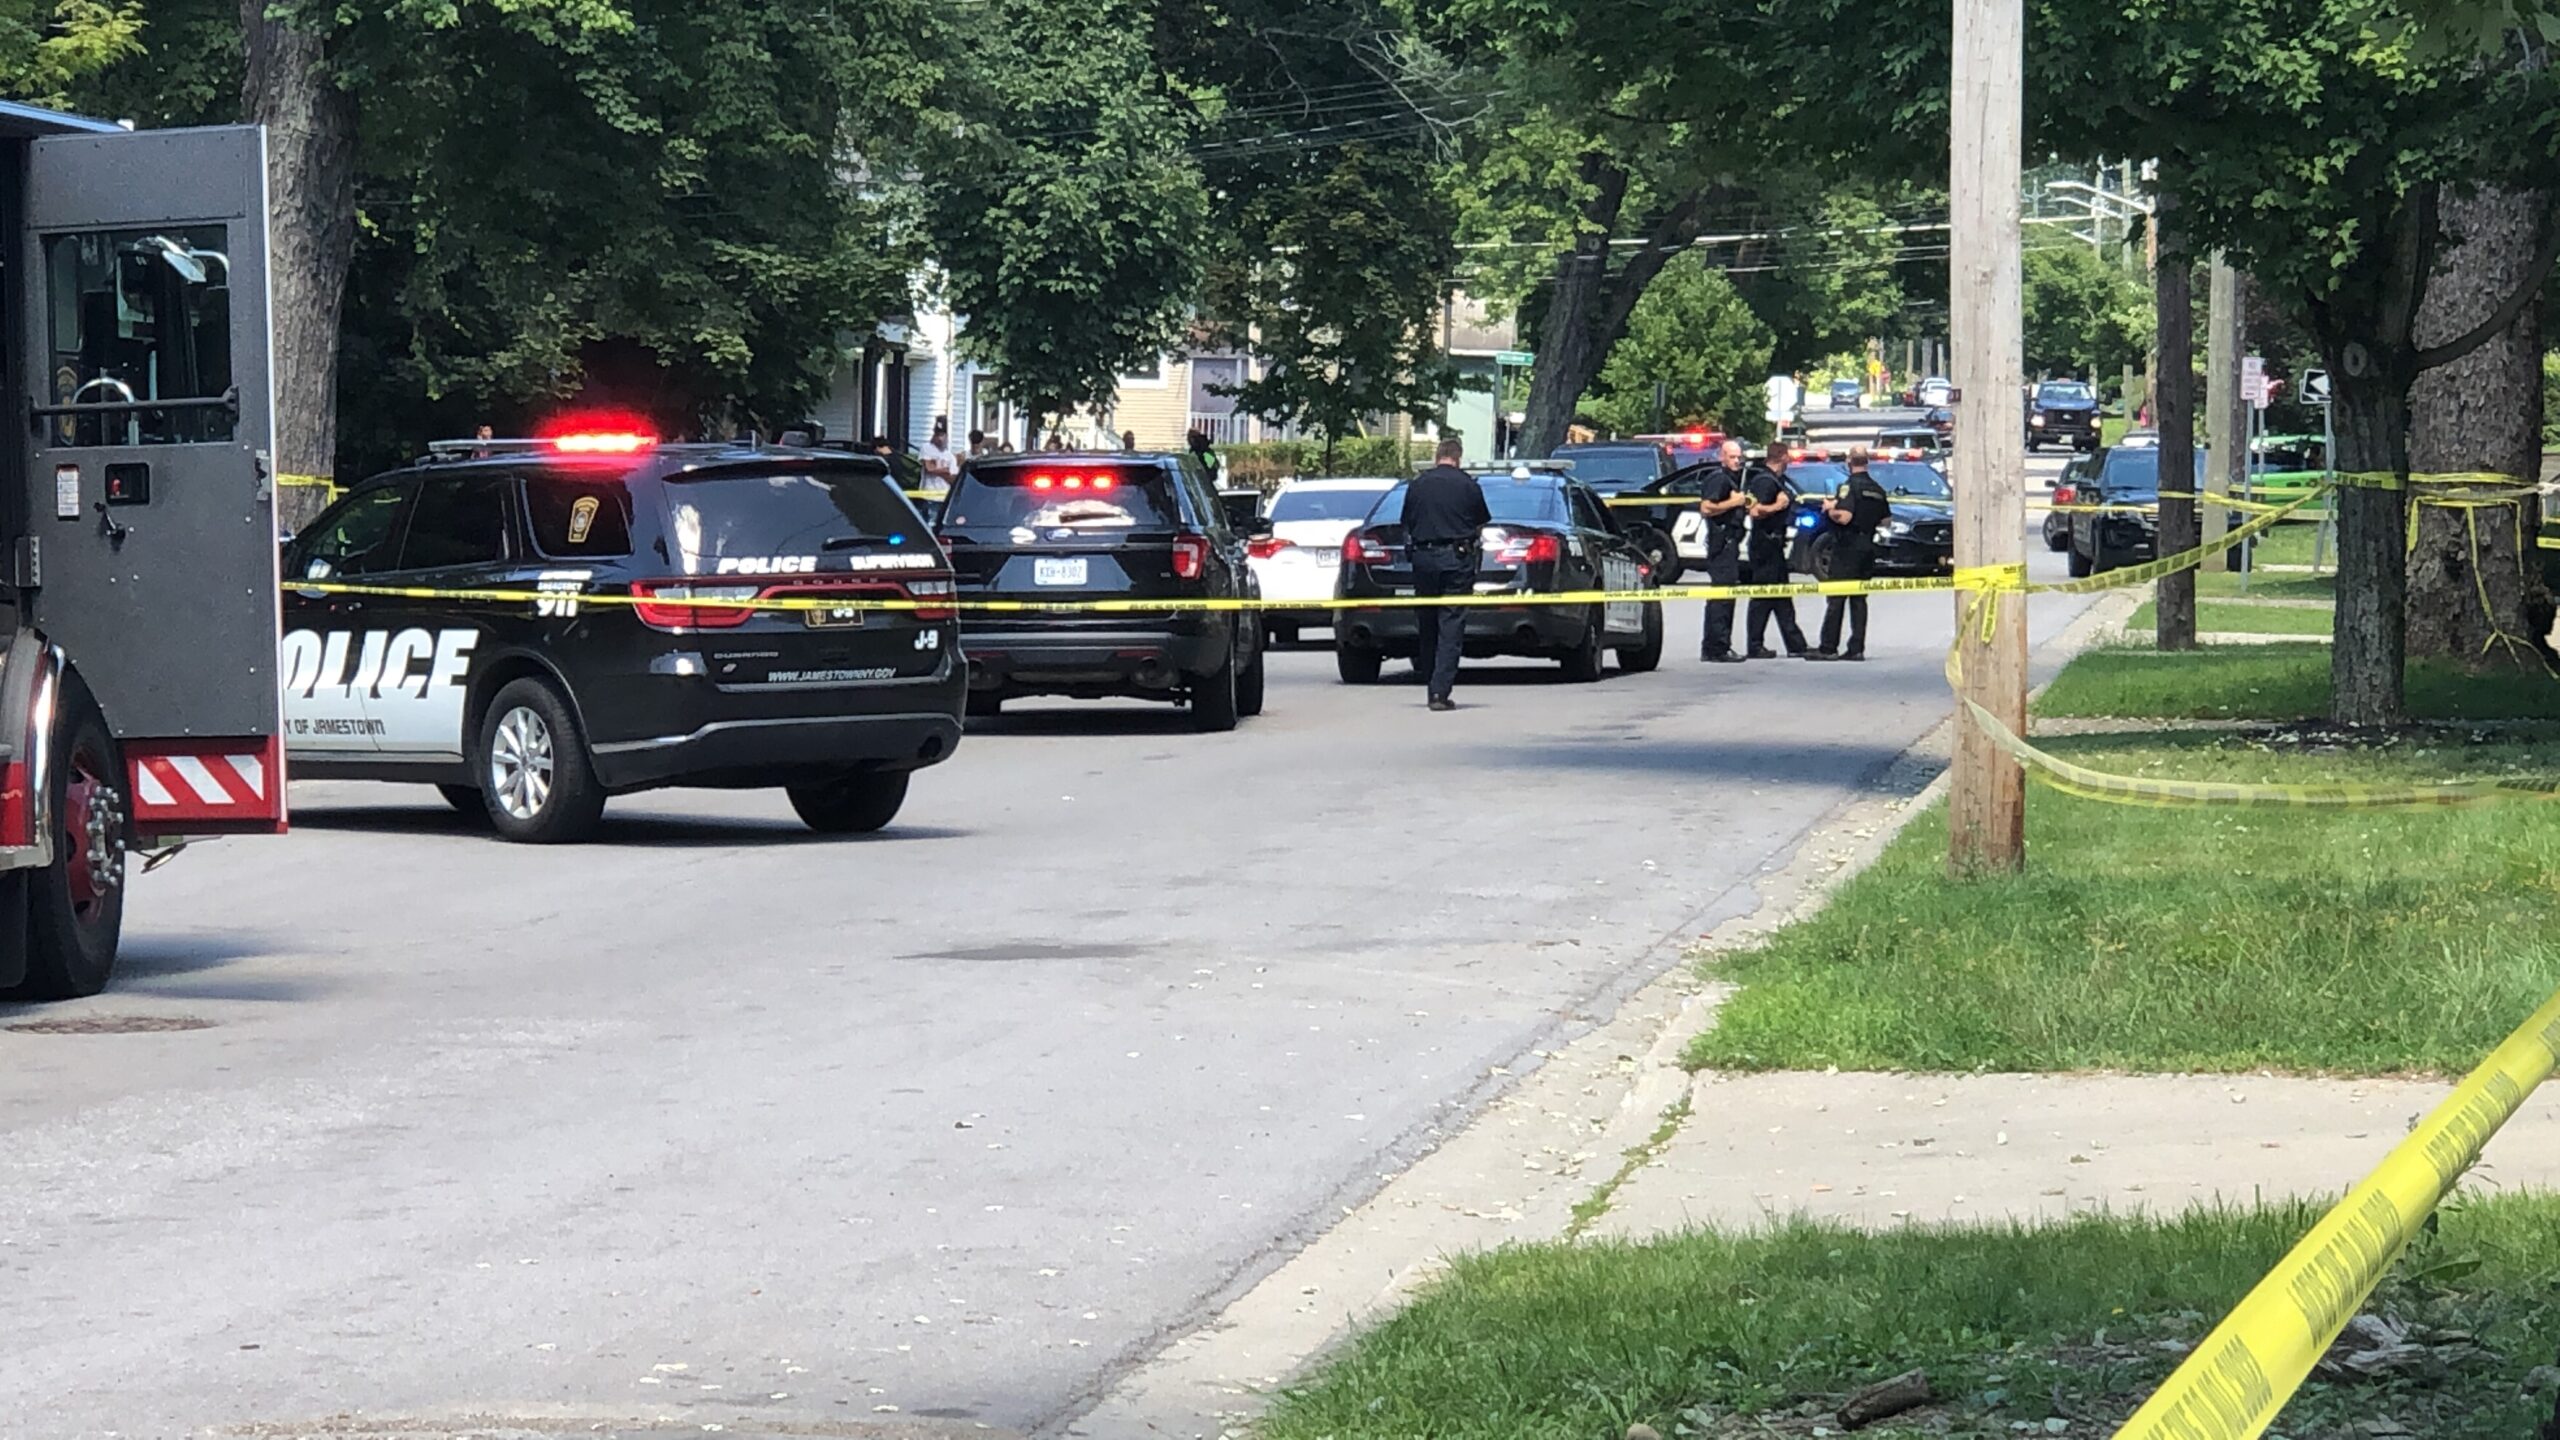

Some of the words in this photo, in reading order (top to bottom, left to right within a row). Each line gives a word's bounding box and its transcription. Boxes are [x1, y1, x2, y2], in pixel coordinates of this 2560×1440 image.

[717, 556, 818, 574] POLICE
[537, 590, 579, 617] 911
[283, 627, 479, 699] OLICE
[768, 667, 896, 682] WWW.JAMESTOWNNY.GOV
[294, 719, 308, 735] OF
[312, 718, 386, 735] JAMESTOWN
